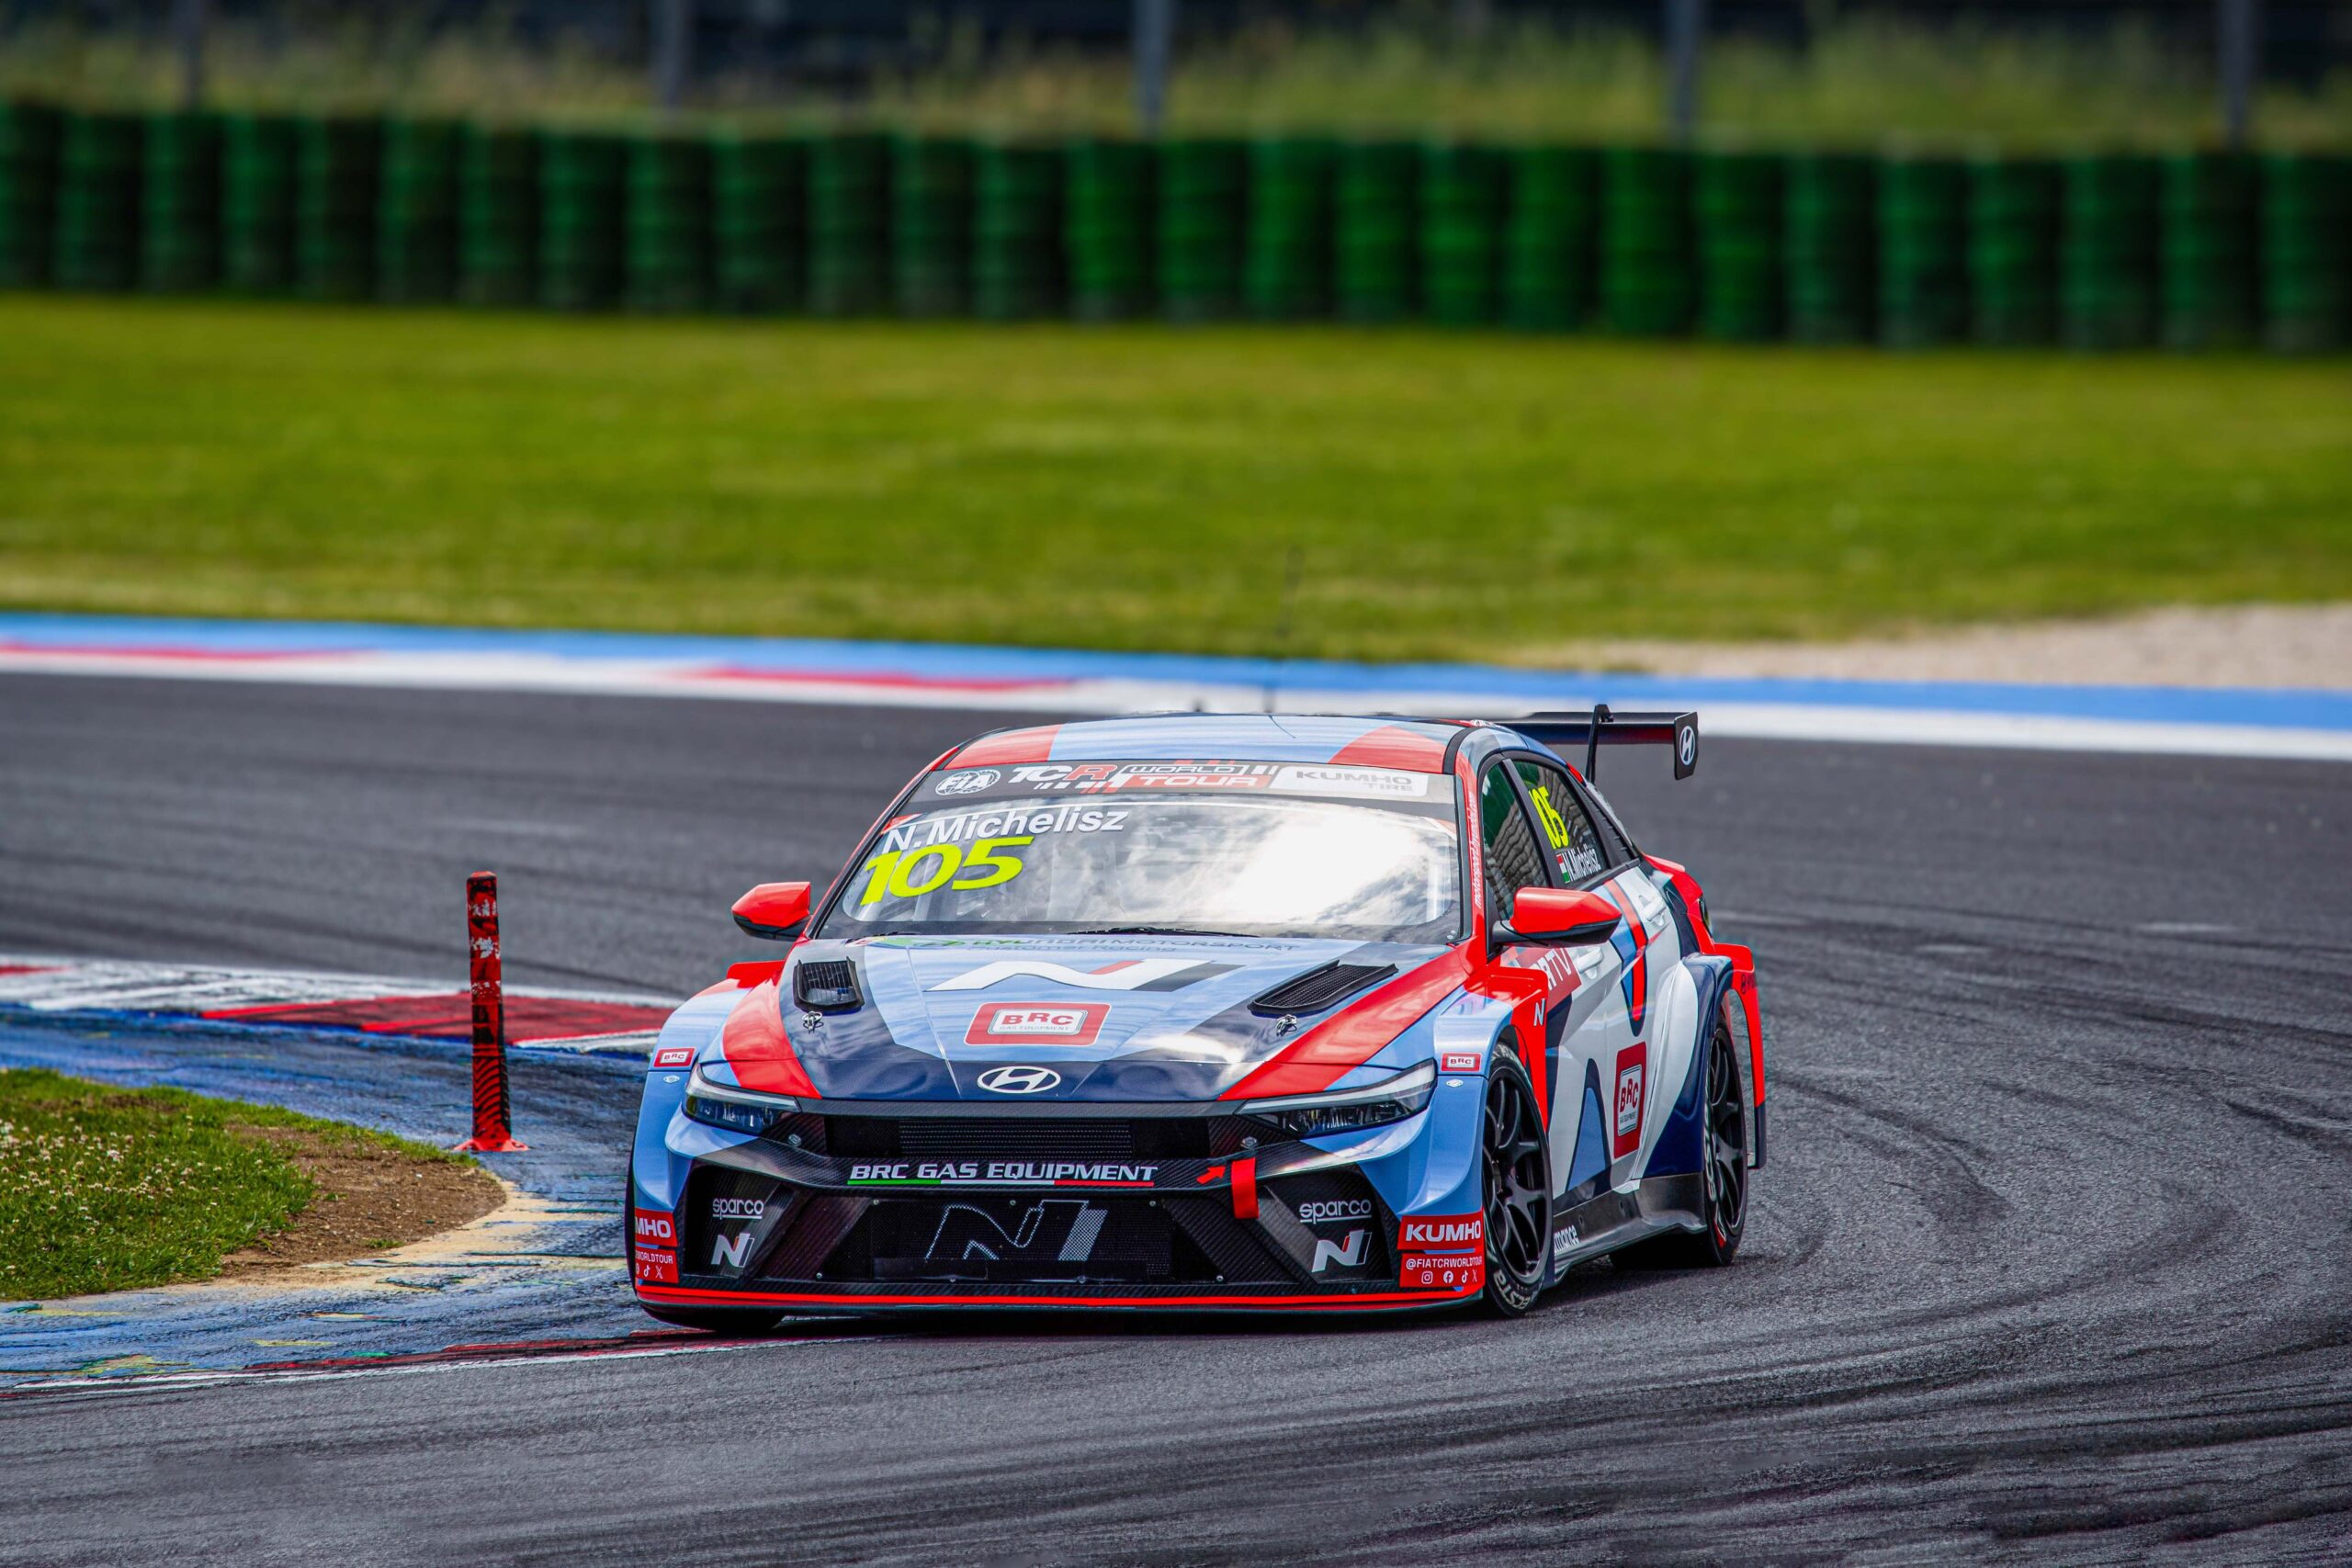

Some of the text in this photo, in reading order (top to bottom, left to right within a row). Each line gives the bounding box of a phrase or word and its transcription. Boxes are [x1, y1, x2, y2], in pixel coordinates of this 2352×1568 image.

[1009, 764, 1118, 784] TCR
[1130, 765, 1236, 774] WORLD
[1295, 771, 1412, 784] KUMHO
[939, 774, 989, 794] FIA
[1139, 775, 1259, 787] TOUR
[1363, 783, 1413, 792] TIRE
[860, 836, 1035, 906] 105
[1110, 939, 1302, 951] MOTORSPORT
[1001, 1012, 1074, 1025] BRC
[1620, 1078, 1639, 1112] BRC
[850, 1163, 1159, 1181] BRC GAS EQUIPMENT
[713, 1198, 764, 1220] sparco
[1299, 1198, 1373, 1224] sparco
[1405, 1219, 1482, 1242] KUMHO
[1406, 1256, 1483, 1270] @FIATCRWORLDTOUR
